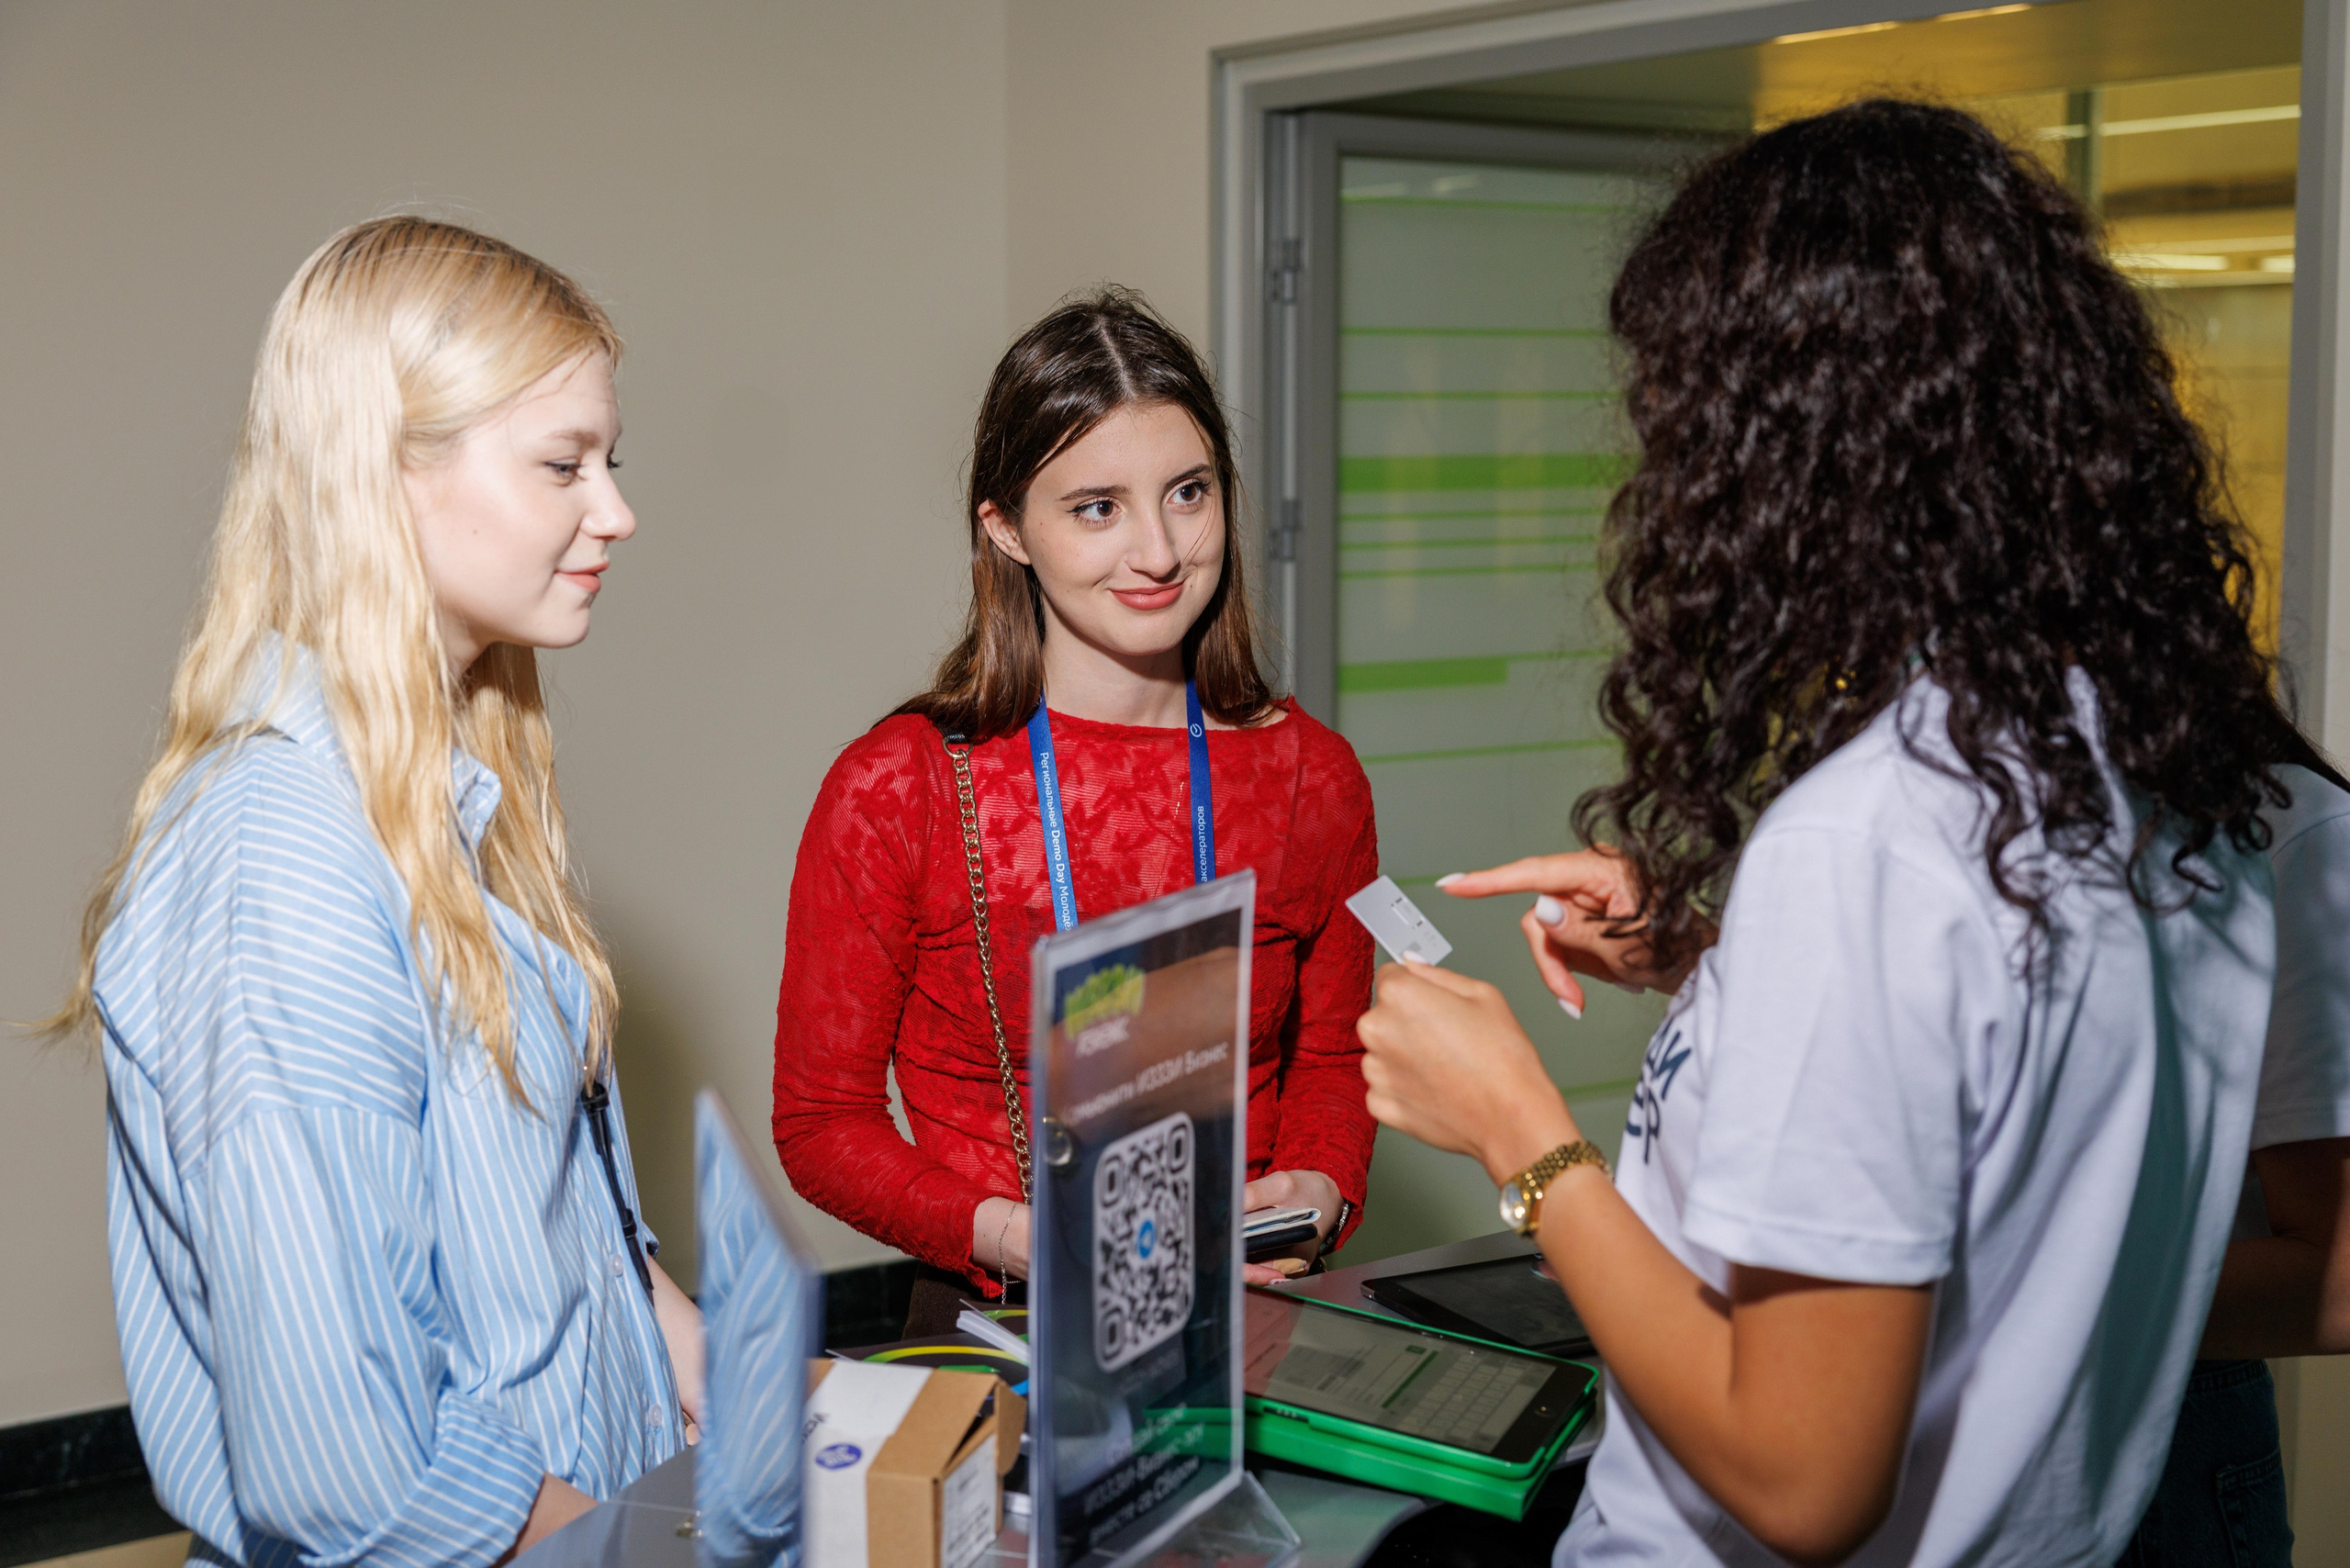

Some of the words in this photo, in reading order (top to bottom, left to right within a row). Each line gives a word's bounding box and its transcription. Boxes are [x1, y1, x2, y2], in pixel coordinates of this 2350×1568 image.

[1039, 752, 1058, 828] Региональные
[1051, 829, 1063, 861] Demo
[1197, 805, 1208, 882] акселераторов
[1056, 863, 1066, 884] Day
